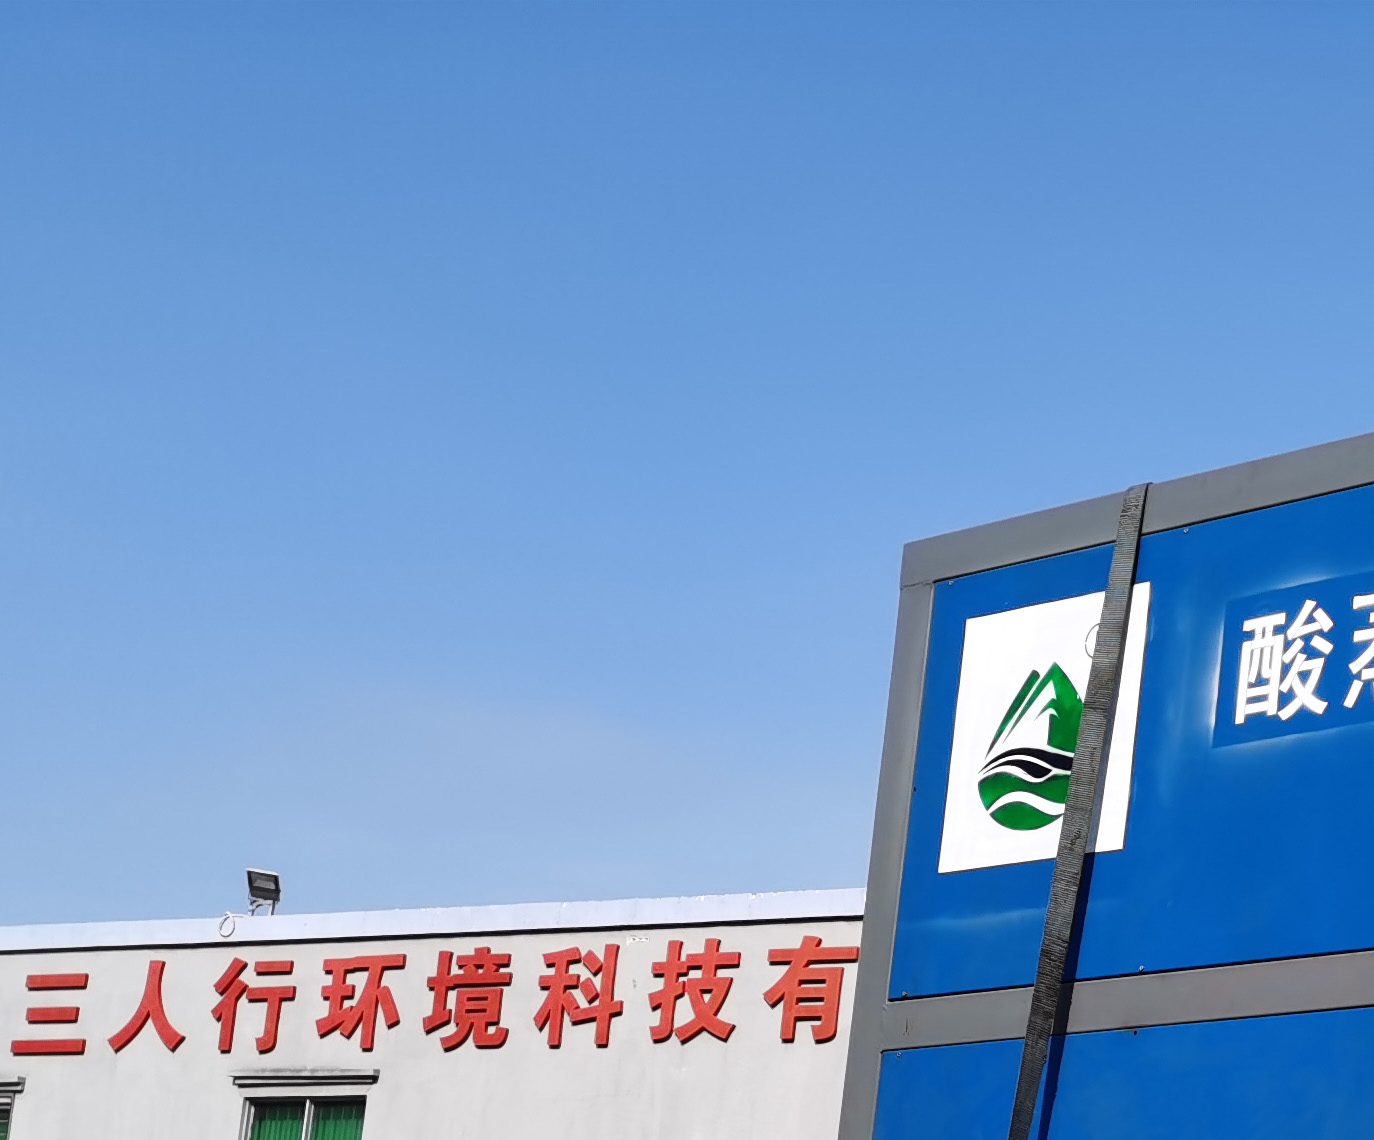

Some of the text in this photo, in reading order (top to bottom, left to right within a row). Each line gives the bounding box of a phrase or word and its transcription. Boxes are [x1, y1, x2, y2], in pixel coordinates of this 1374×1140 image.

[11, 935, 859, 1055] 三人行环境科技有
